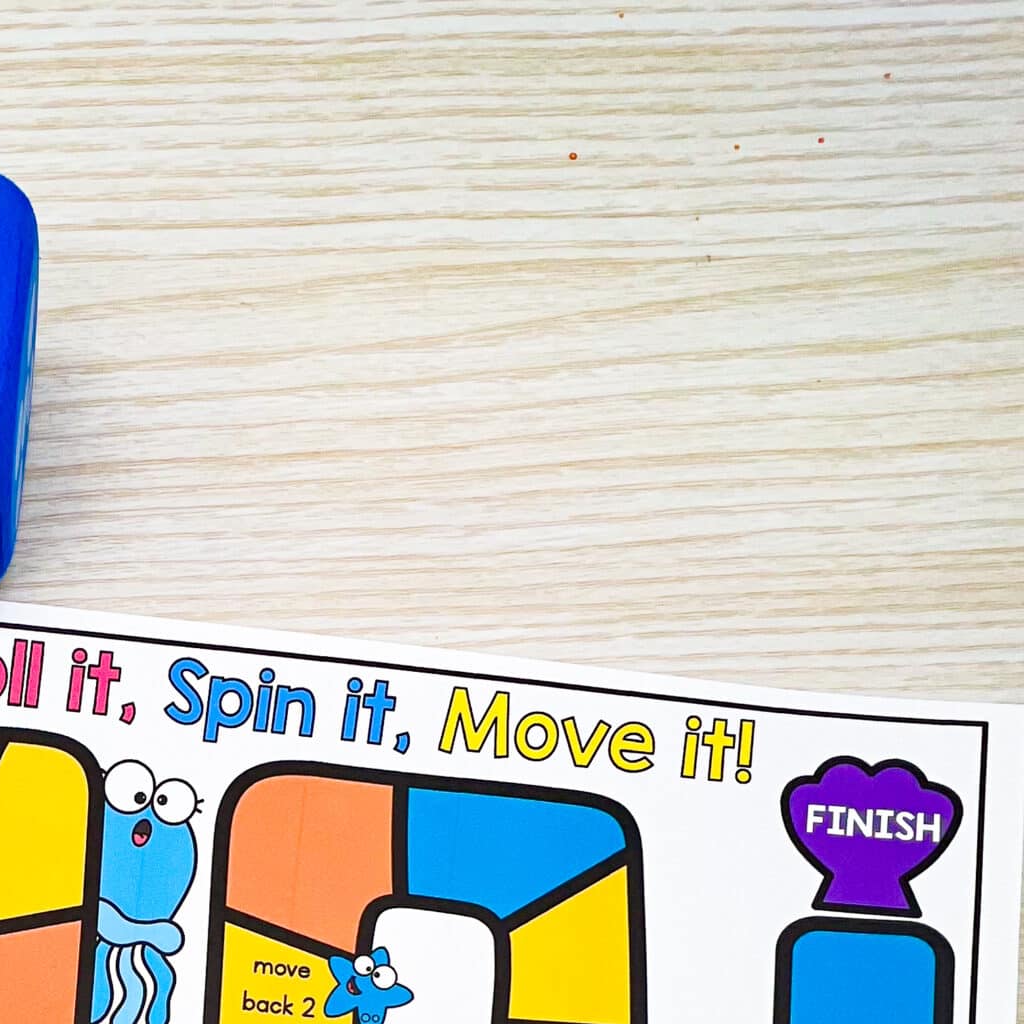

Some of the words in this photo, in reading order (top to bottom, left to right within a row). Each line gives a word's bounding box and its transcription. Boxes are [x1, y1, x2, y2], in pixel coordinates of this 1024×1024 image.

[66, 649, 136, 725] it,
[164, 657, 316, 743] Spin
[341, 677, 411, 754] it,
[438, 686, 656, 772] Move
[680, 715, 756, 784] it!
[805, 803, 942, 843] FINISH
[253, 960, 311, 978] move
[242, 990, 293, 1015] back
[301, 997, 316, 1018] 2
